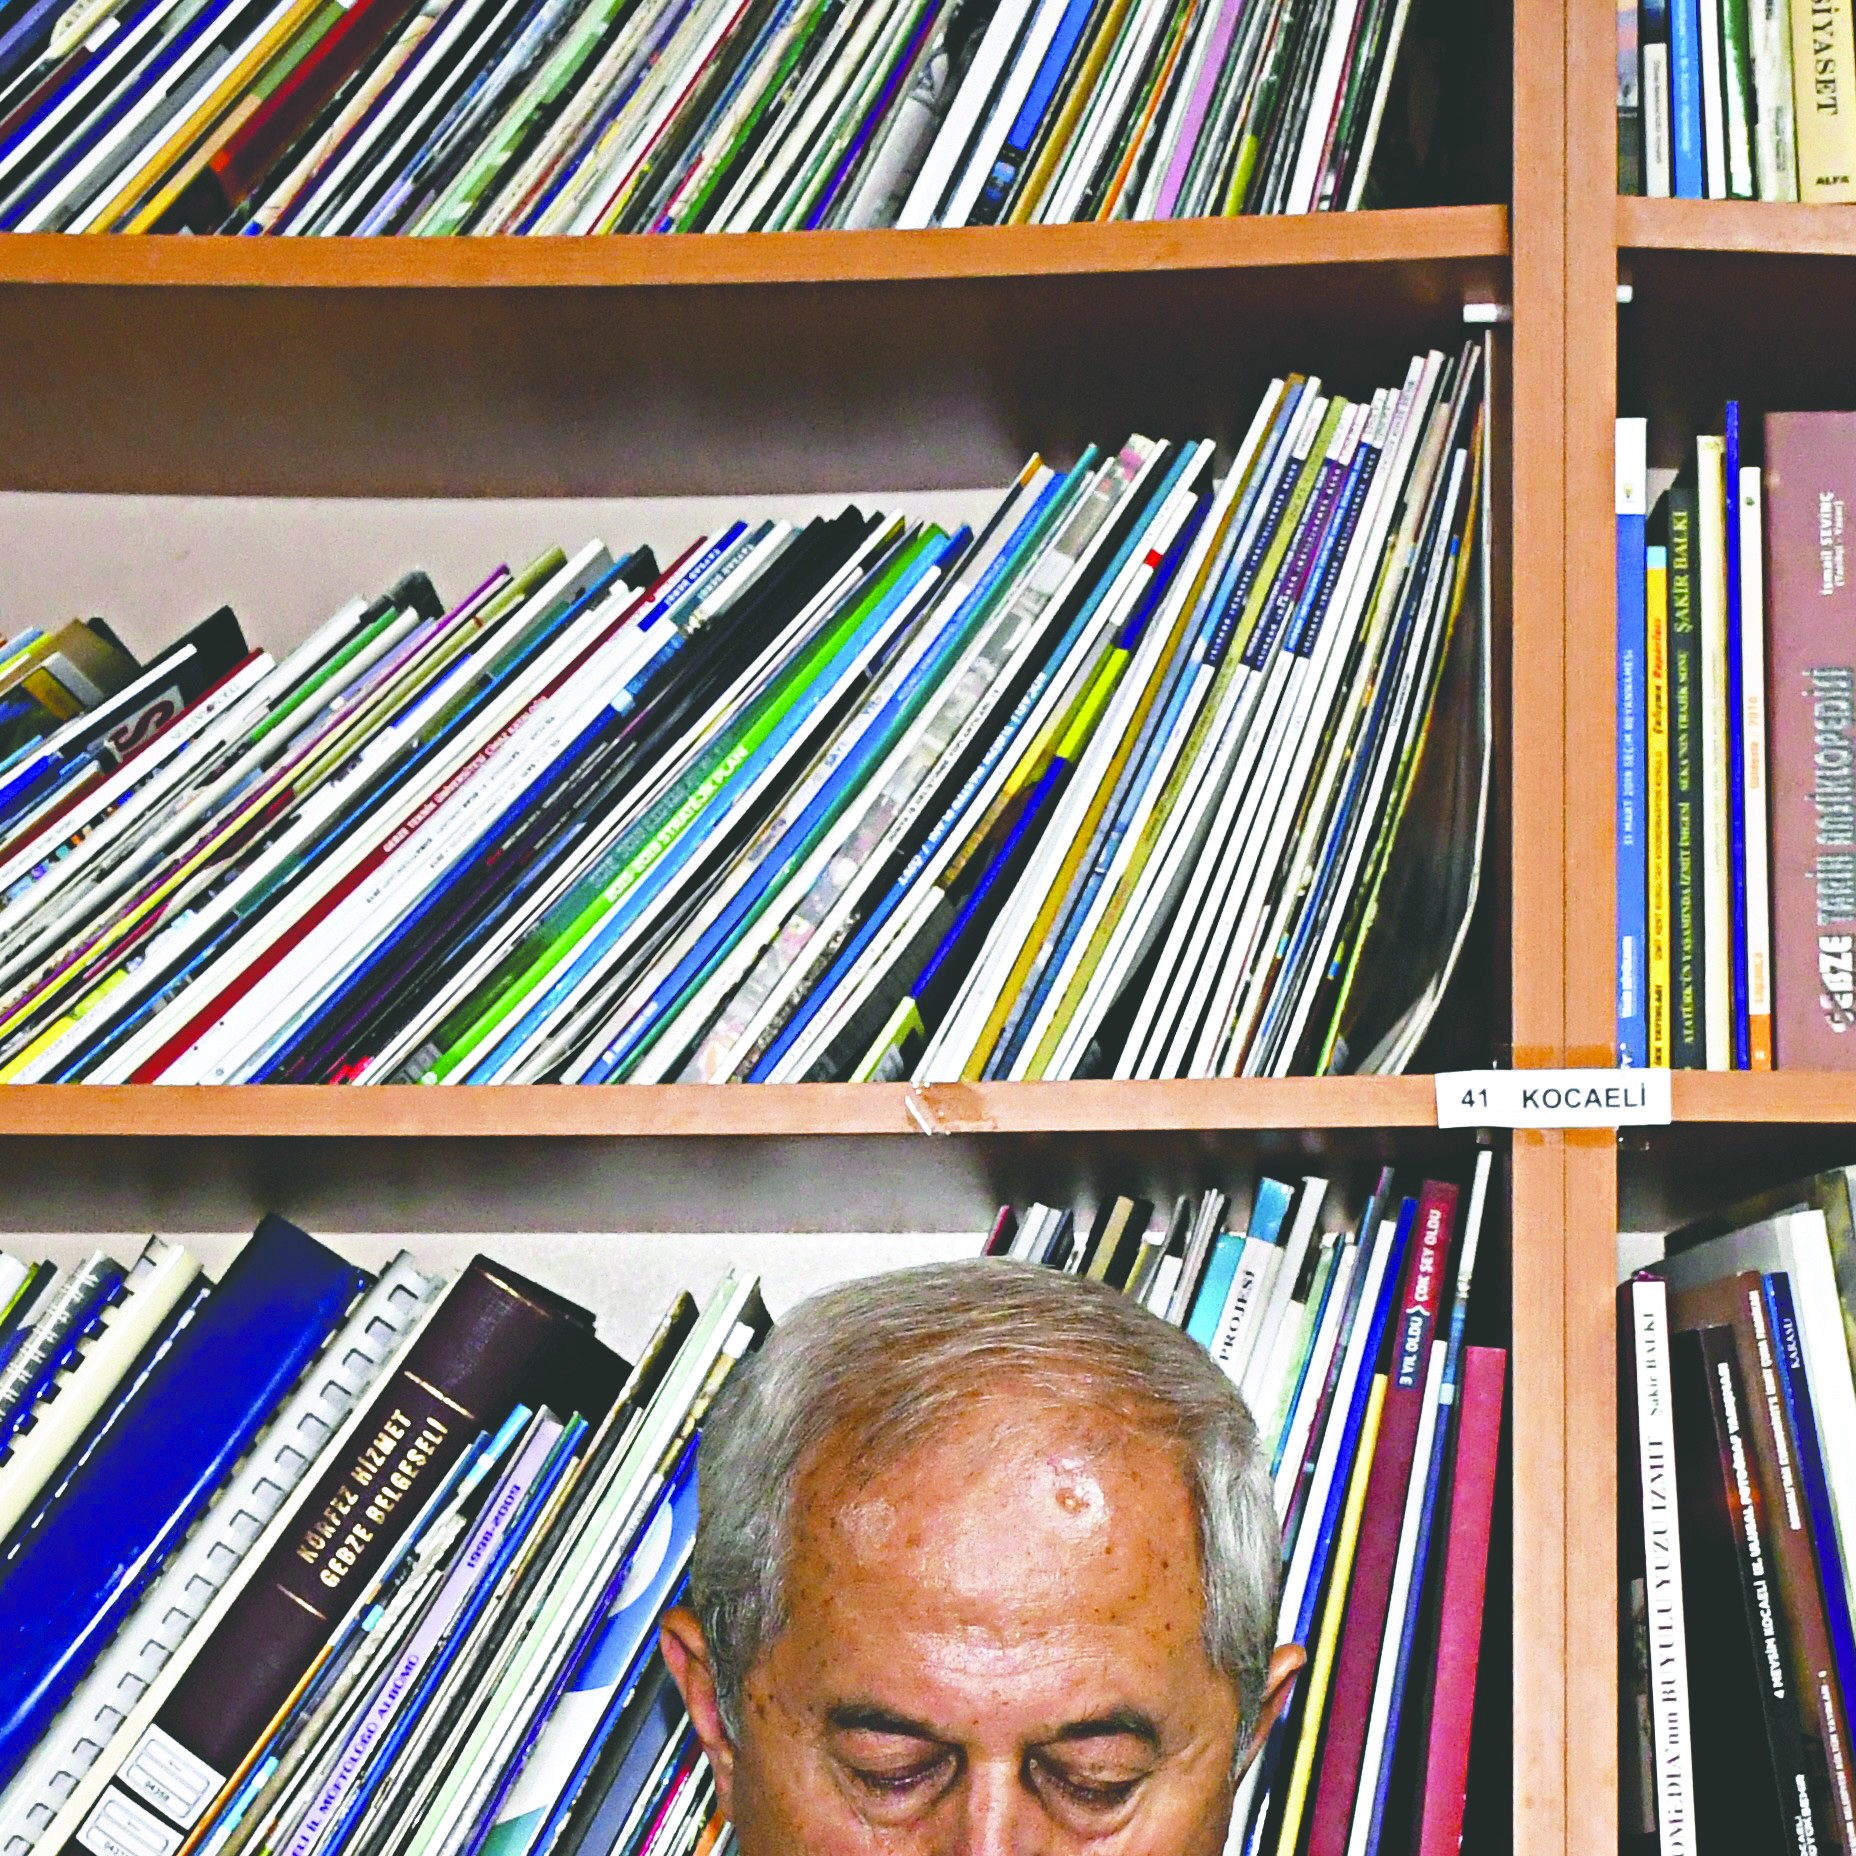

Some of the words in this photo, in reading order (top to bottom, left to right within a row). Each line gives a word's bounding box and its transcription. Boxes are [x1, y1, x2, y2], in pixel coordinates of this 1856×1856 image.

[1818, 935, 1856, 1032] GEBZE
[1461, 1089, 1487, 1107] 41
[1522, 1082, 1645, 1108] KOCAELİ
[294, 1483, 360, 1565] KÖRFEZ
[347, 1405, 413, 1487] HİZMET
[315, 1520, 374, 1590] GEBZE
[361, 1415, 449, 1526] BELGESELİ
